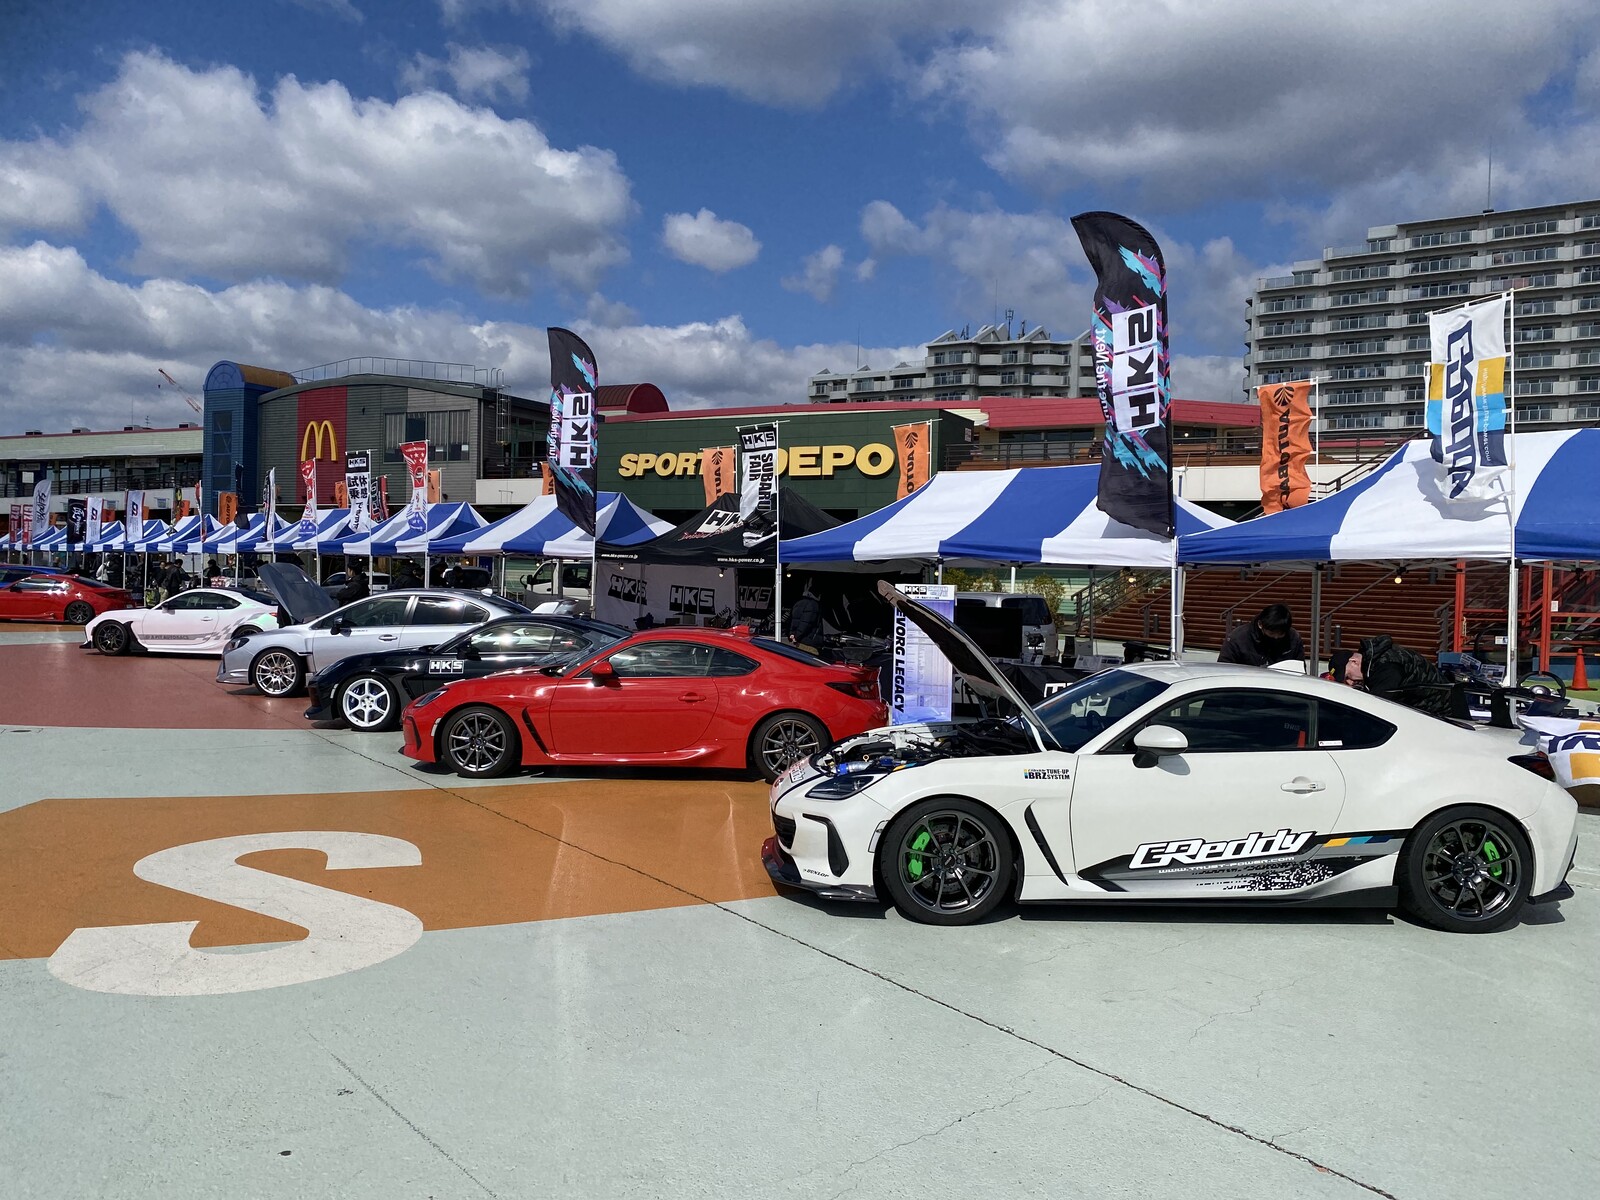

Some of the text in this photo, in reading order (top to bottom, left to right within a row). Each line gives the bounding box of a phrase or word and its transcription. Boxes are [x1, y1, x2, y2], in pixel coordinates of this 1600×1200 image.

[742, 432, 775, 445] HKS
[749, 454, 761, 481] FAIR
[757, 452, 774, 511] SUBARU
[705, 511, 741, 527] HK
[717, 556, 765, 564] www.hks-power.co.jp
[611, 576, 648, 599] HKS
[739, 586, 772, 602] HKS
[904, 585, 927, 594] HKS
[670, 586, 714, 609] HKS
[430, 661, 463, 670] HKS
[893, 658, 906, 713] LEGACY
[1128, 829, 1314, 869] GReddy
